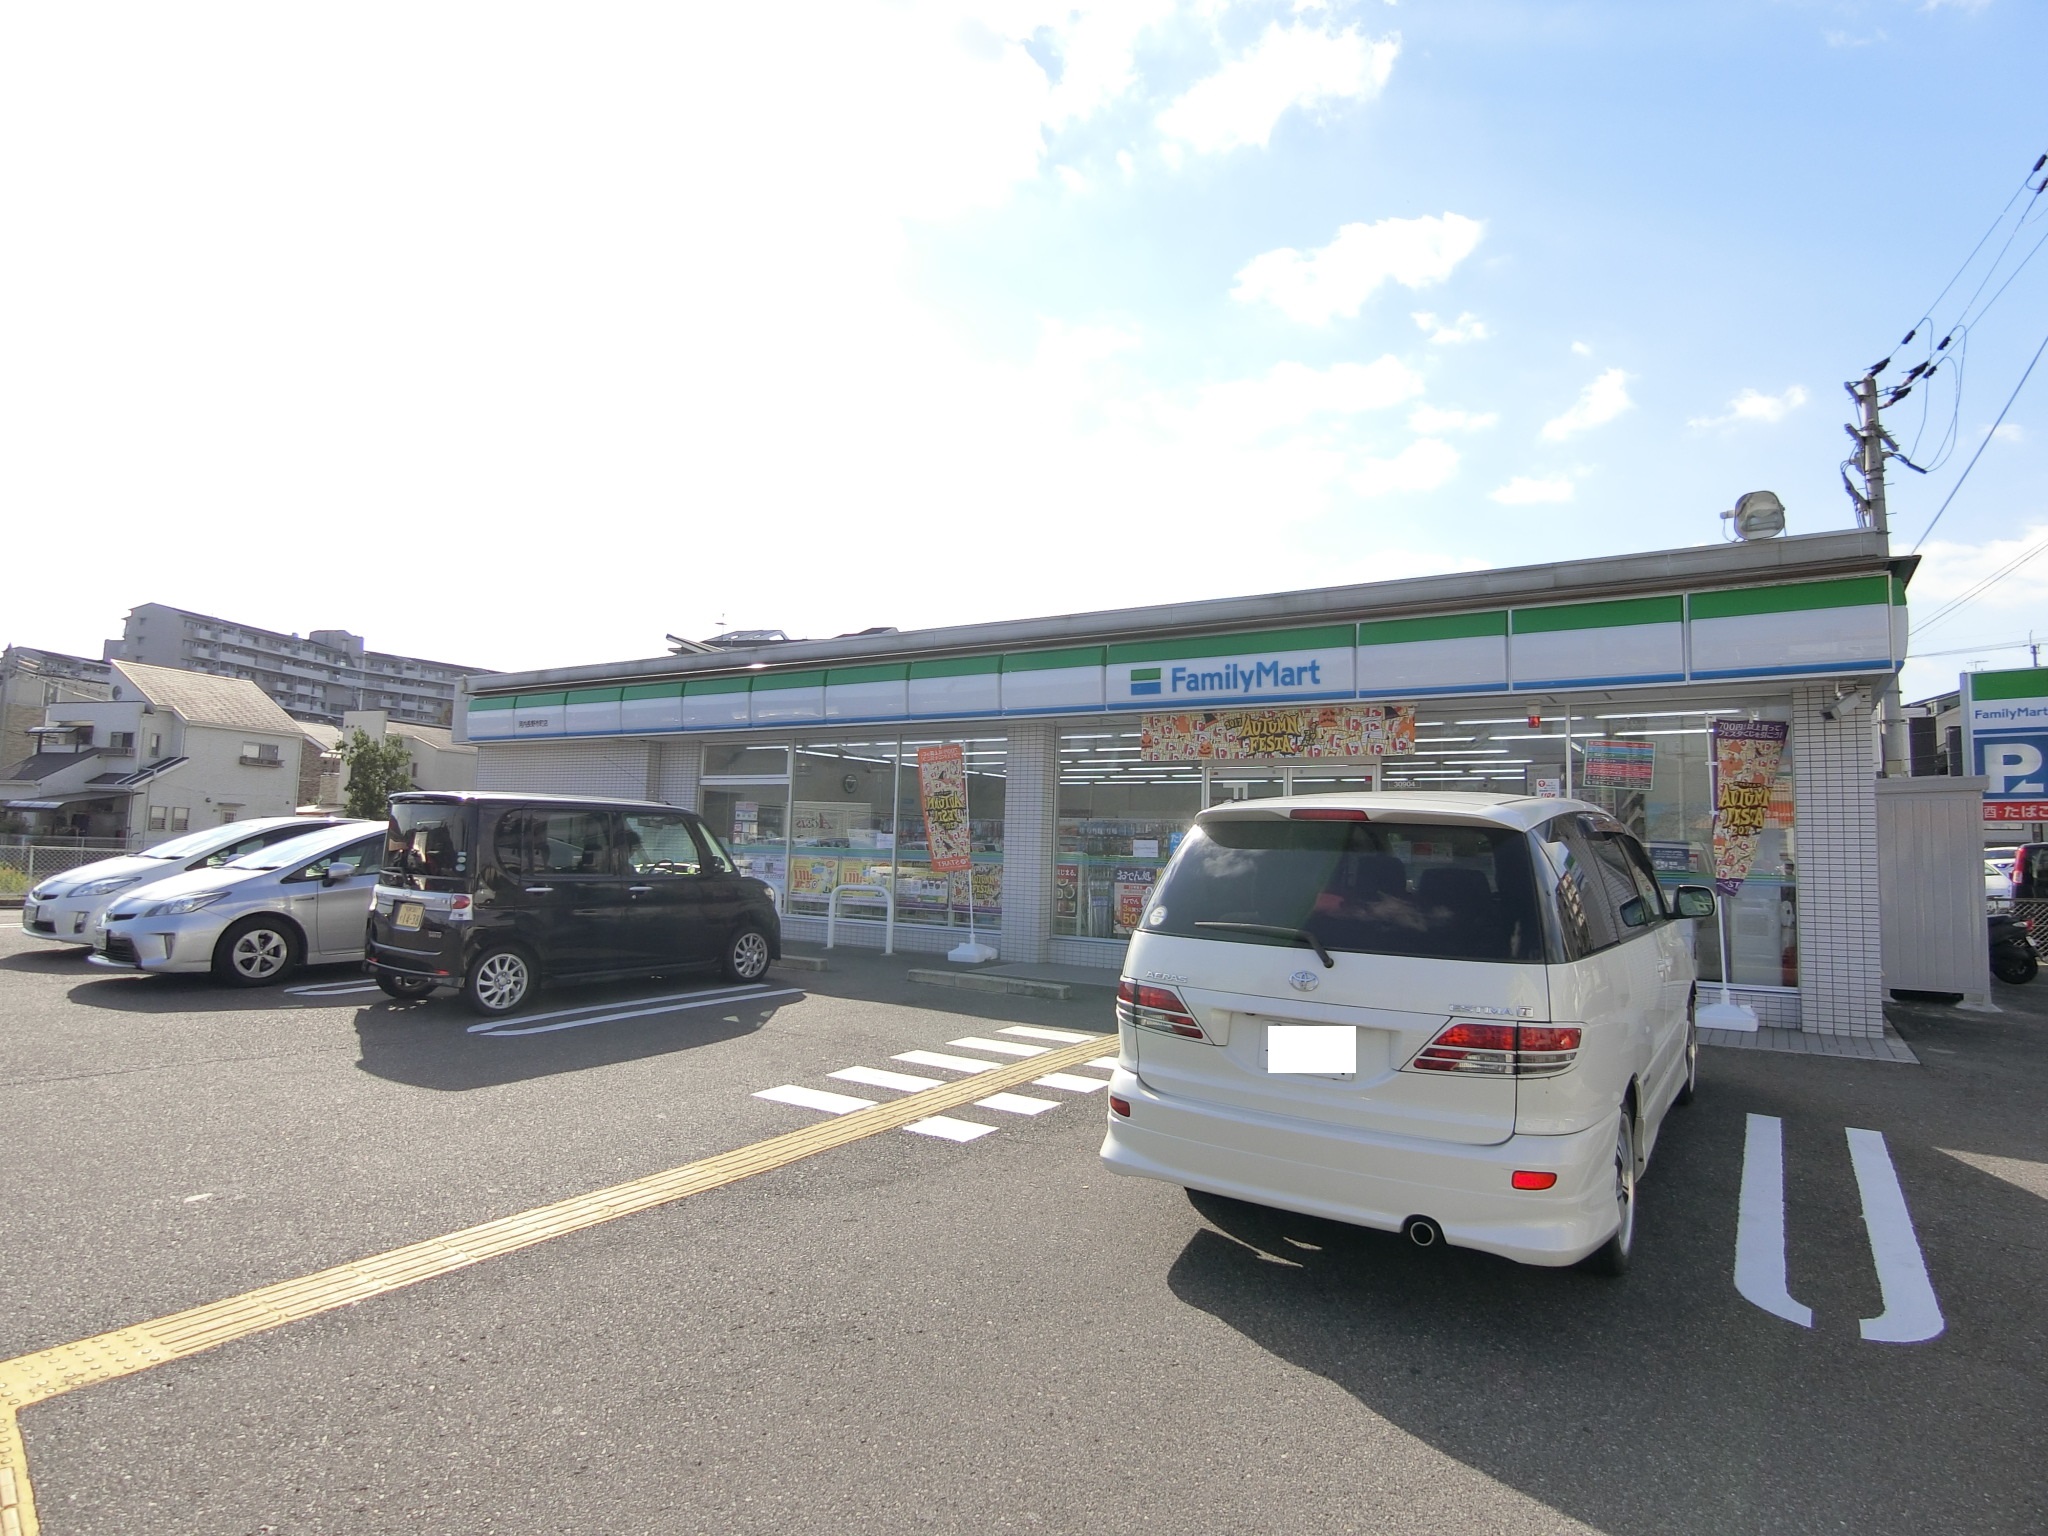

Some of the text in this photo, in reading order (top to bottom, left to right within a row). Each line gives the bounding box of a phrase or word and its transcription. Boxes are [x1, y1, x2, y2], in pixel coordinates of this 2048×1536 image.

[1171, 660, 1321, 693] FamilyMart
[1975, 707, 2048, 720] FamilyMart
[1239, 714, 1300, 738] AUTUMN
[1247, 735, 1294, 756] FESTA
[1984, 744, 2042, 793] P
[1145, 970, 1188, 983] AERAS
[1448, 1003, 1514, 1016] ESTIMA
